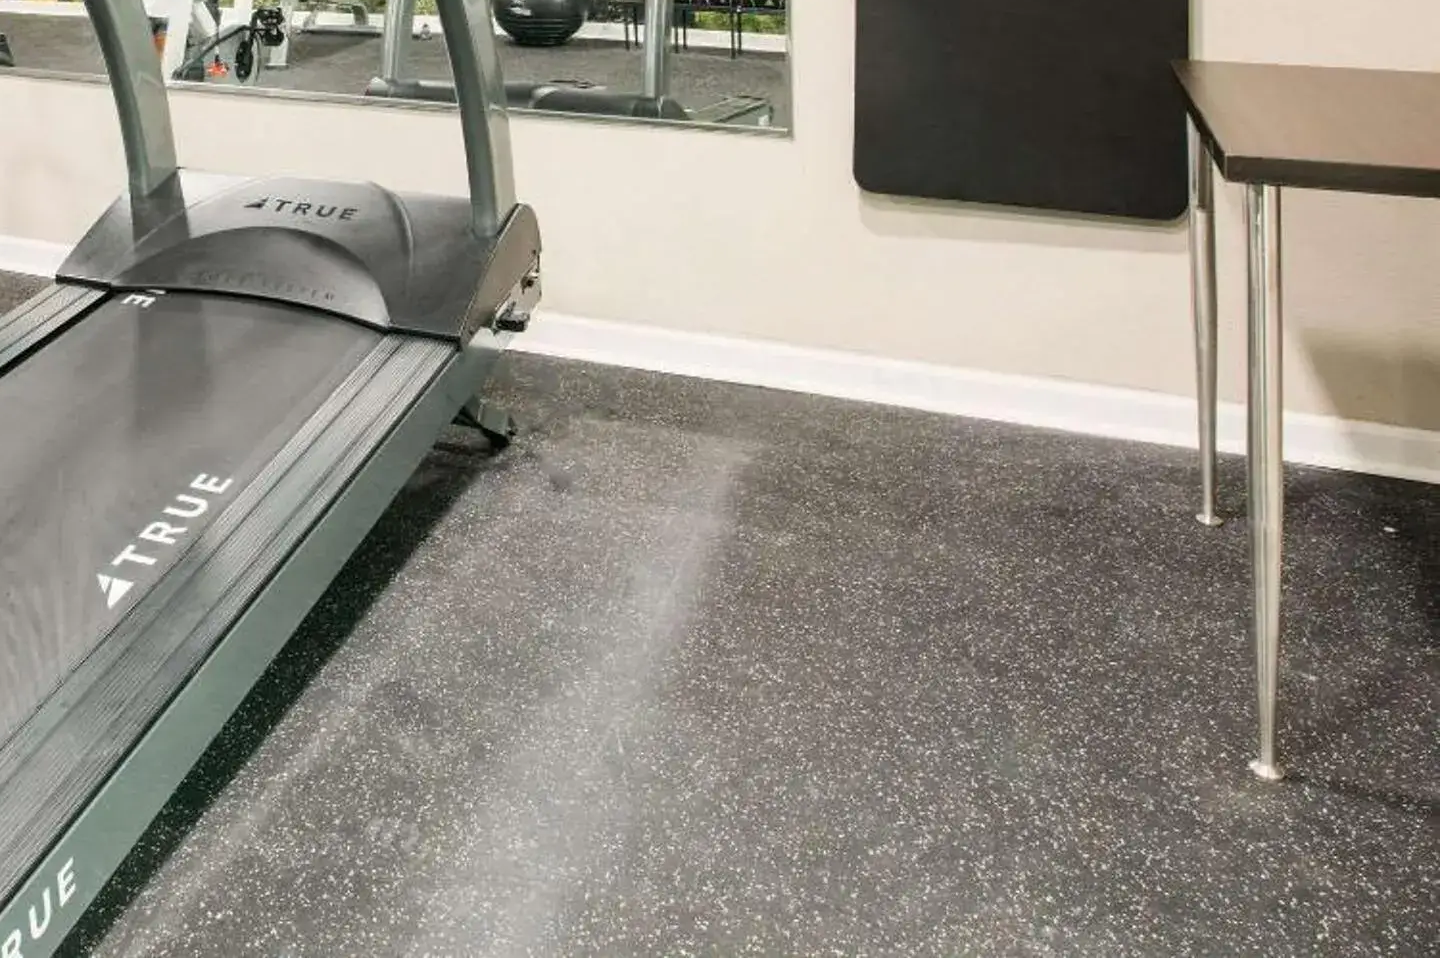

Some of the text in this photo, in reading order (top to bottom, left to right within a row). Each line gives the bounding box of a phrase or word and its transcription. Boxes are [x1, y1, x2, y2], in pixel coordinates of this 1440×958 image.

[276, 199, 358, 220] TRUE
[111, 473, 234, 565] TRUE
[1, 856, 77, 958] RUE
